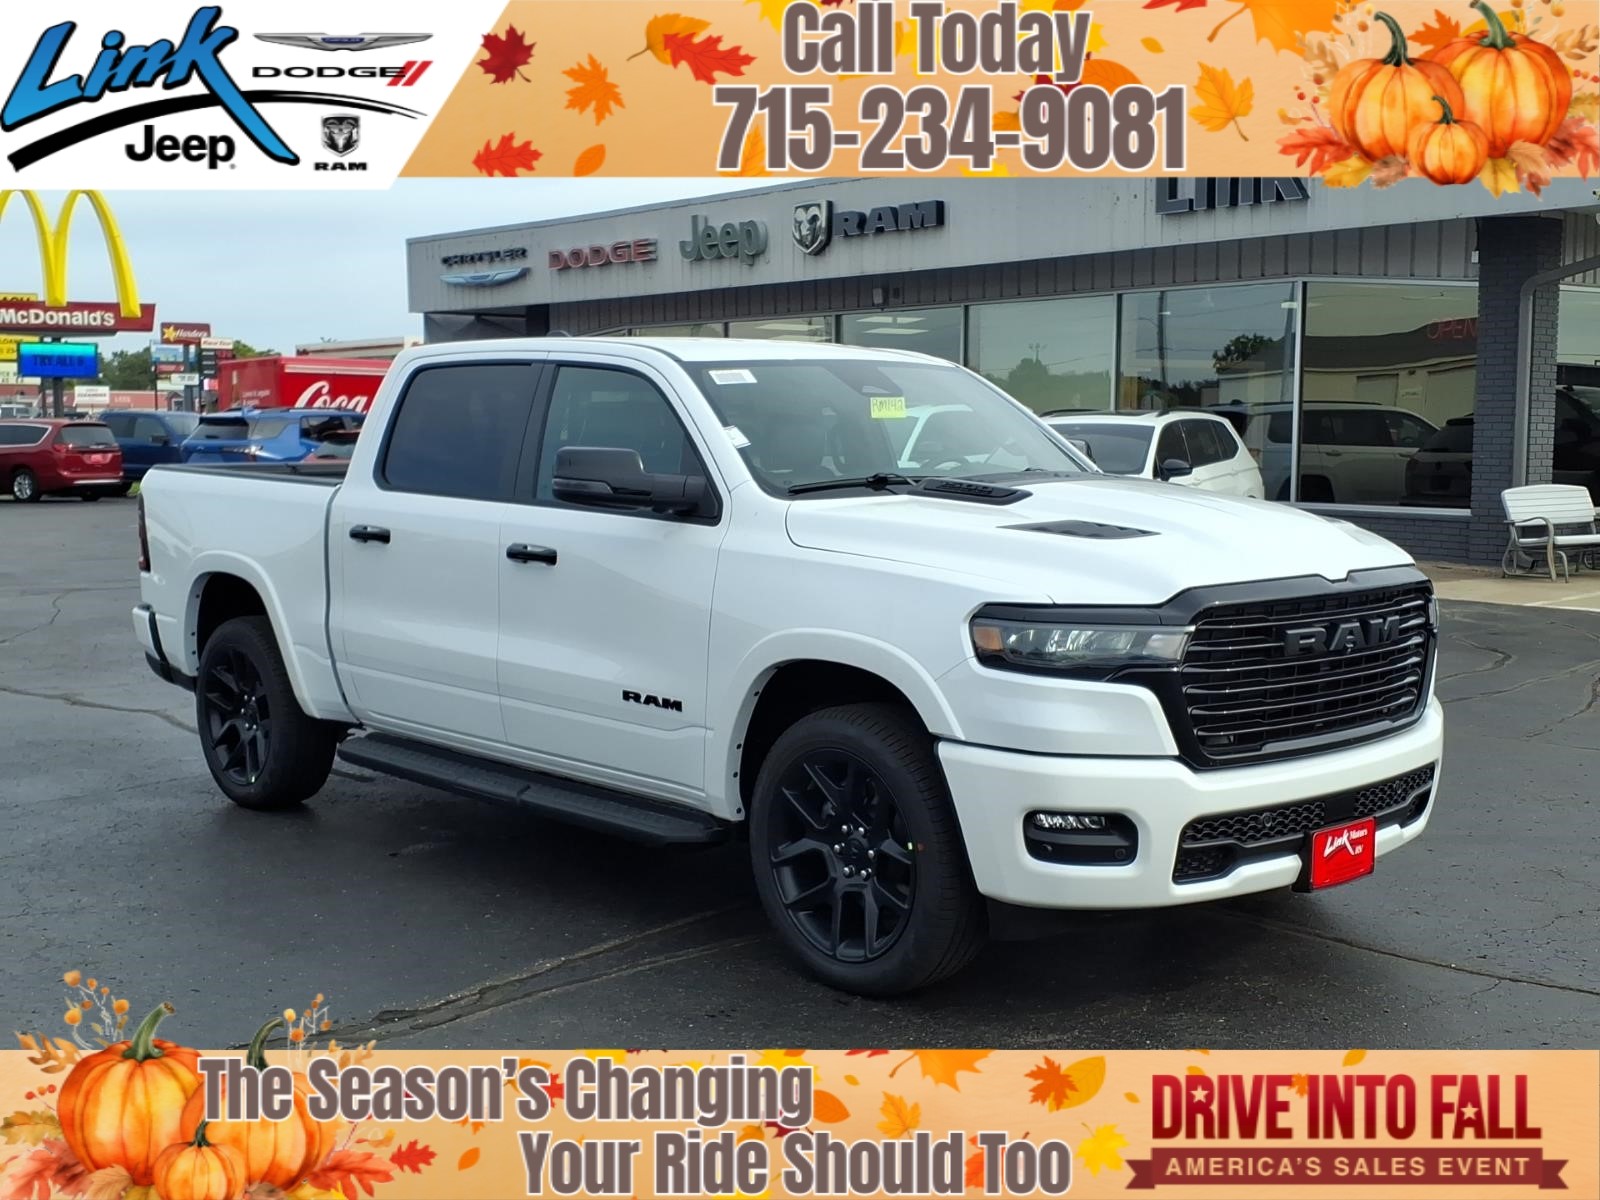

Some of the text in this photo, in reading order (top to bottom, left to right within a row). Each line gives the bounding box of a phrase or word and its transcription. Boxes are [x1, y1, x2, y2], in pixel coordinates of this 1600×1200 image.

[833, 200, 945, 237] RAM
[548, 238, 658, 271] DODGE
[679, 214, 768, 266] Jeep
[0, 308, 115, 326] McDonald's
[1284, 615, 1400, 657] RAM
[622, 689, 683, 712] RAM
[1323, 829, 1356, 858] Link
